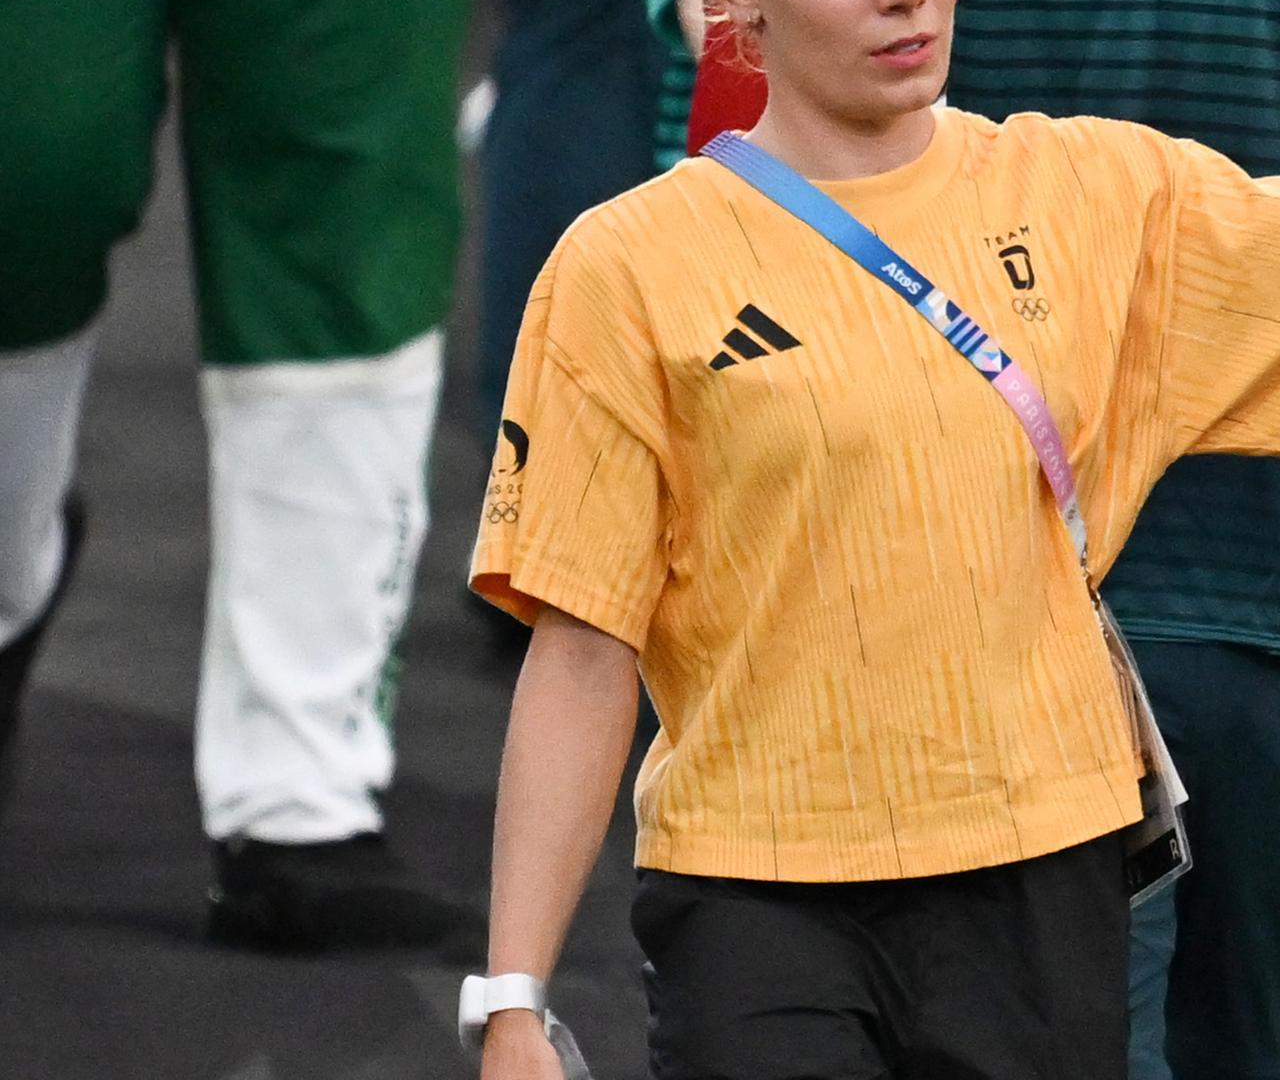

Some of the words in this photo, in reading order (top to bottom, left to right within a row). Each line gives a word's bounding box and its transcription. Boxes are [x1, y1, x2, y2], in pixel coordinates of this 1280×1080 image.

[984, 225, 1030, 248] TEAM
[881, 262, 922, 295] Atos
[1007, 379, 1049, 439] PARIS
